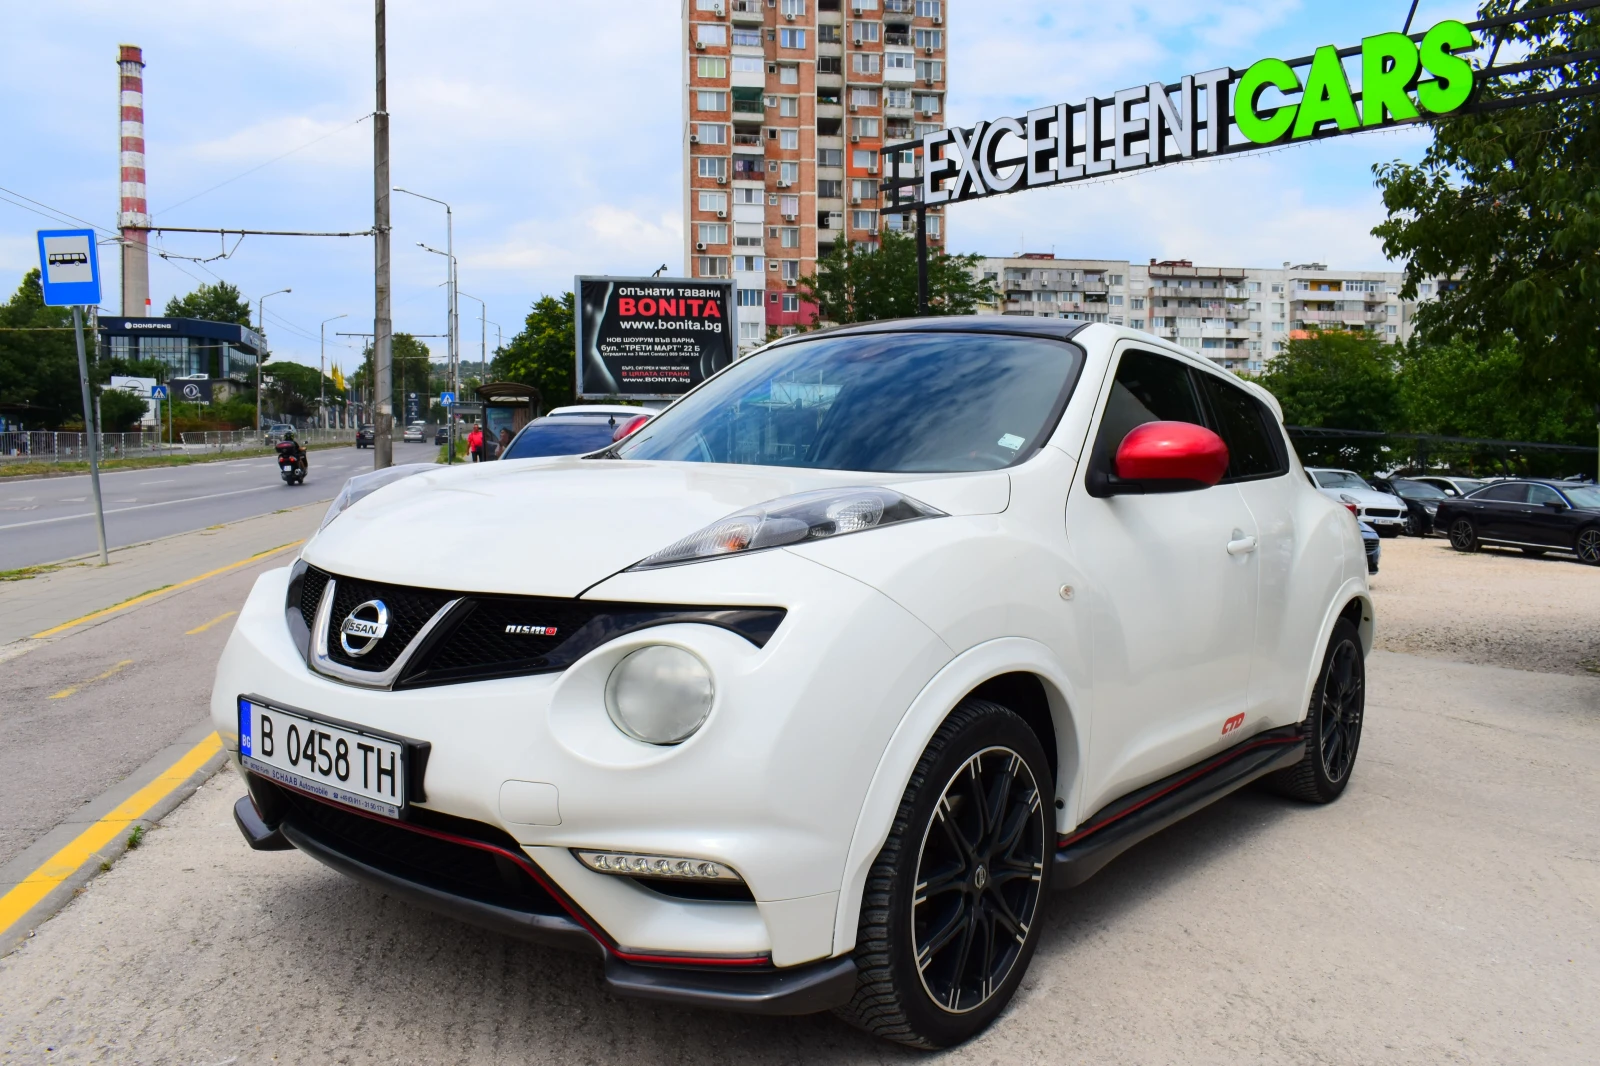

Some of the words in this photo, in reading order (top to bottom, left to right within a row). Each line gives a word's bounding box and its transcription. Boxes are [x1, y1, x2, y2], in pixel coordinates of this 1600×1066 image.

[923, 66, 1234, 203] EXCELLENT
[1233, 20, 1474, 145] CARS
[619, 287, 674, 296] опънати
[678, 288, 720, 298] тавани
[618, 297, 721, 318] BONITA
[620, 319, 722, 333] www.bonita.bg
[601, 344, 619, 353] бул.
[344, 619, 378, 635] NISSAN
[505, 624, 557, 636] nismo
[242, 735, 251, 748] BG
[260, 713, 274, 758] B
[286, 723, 350, 782] 0458
[357, 742, 396, 797] TH
[272, 769, 298, 786] SCHAAB
[298, 780, 329, 796] Automobile
